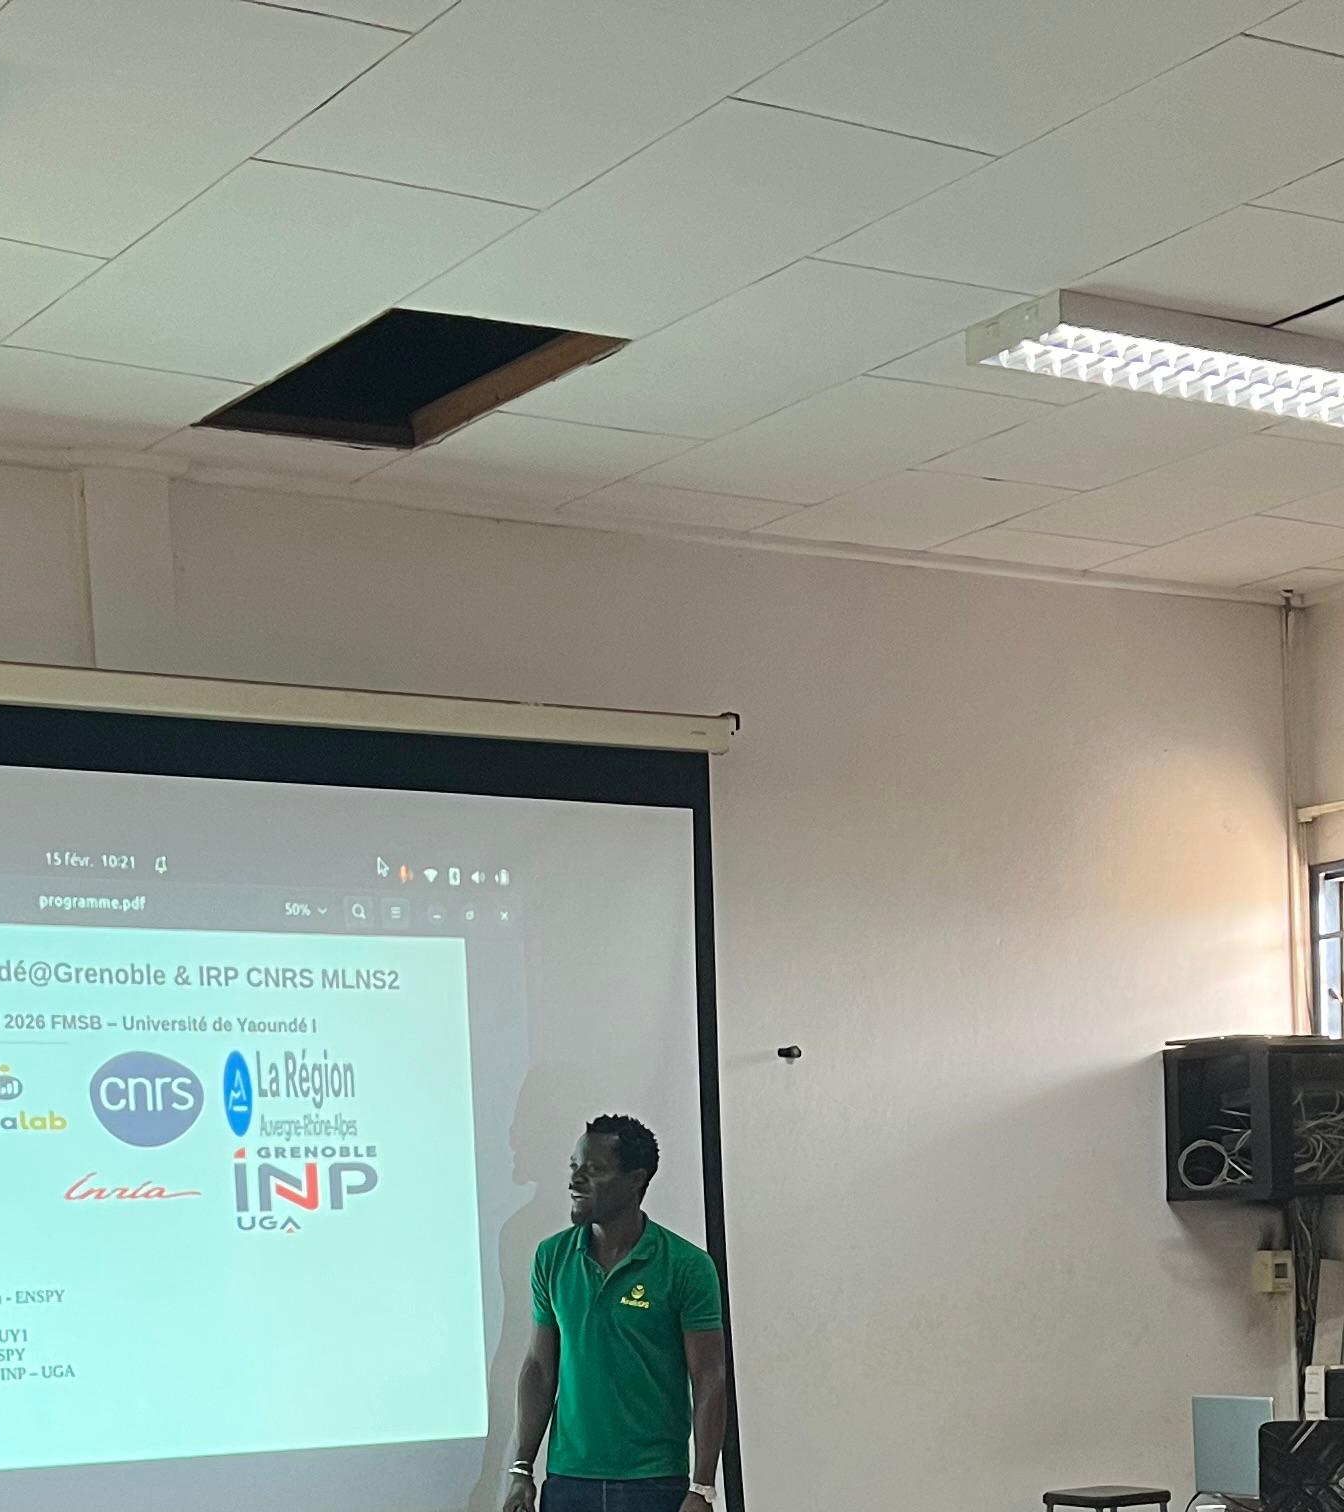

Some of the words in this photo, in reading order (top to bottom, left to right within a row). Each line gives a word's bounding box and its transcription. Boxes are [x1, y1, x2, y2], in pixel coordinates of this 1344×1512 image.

[46, 852, 61, 867] 15
[64, 851, 94, 868] févr.
[102, 854, 135, 869] 10:21
[39, 893, 146, 913] programme.pdf
[284, 902, 311, 917] 50%
[174, 966, 192, 987] &
[199, 966, 239, 988] IRP
[246, 967, 315, 989] CNRS
[321, 968, 401, 991] MLNS2
[4, 1013, 46, 1030] 2026
[51, 1014, 102, 1031] FMSB
[122, 1013, 208, 1033] Université
[212, 1015, 233, 1032] de
[236, 1016, 308, 1034] Yaoundé
[256, 1050, 280, 1098] La
[284, 1048, 356, 1109] Région
[99, 1075, 195, 1112] cnrs
[256, 1146, 377, 1159] GRENOBLE
[237, 1215, 301, 1233] UGA
[15, 1289, 65, 1304] ENSPY
[0, 1367, 27, 1382] INP
[41, 1364, 76, 1379] UGA
